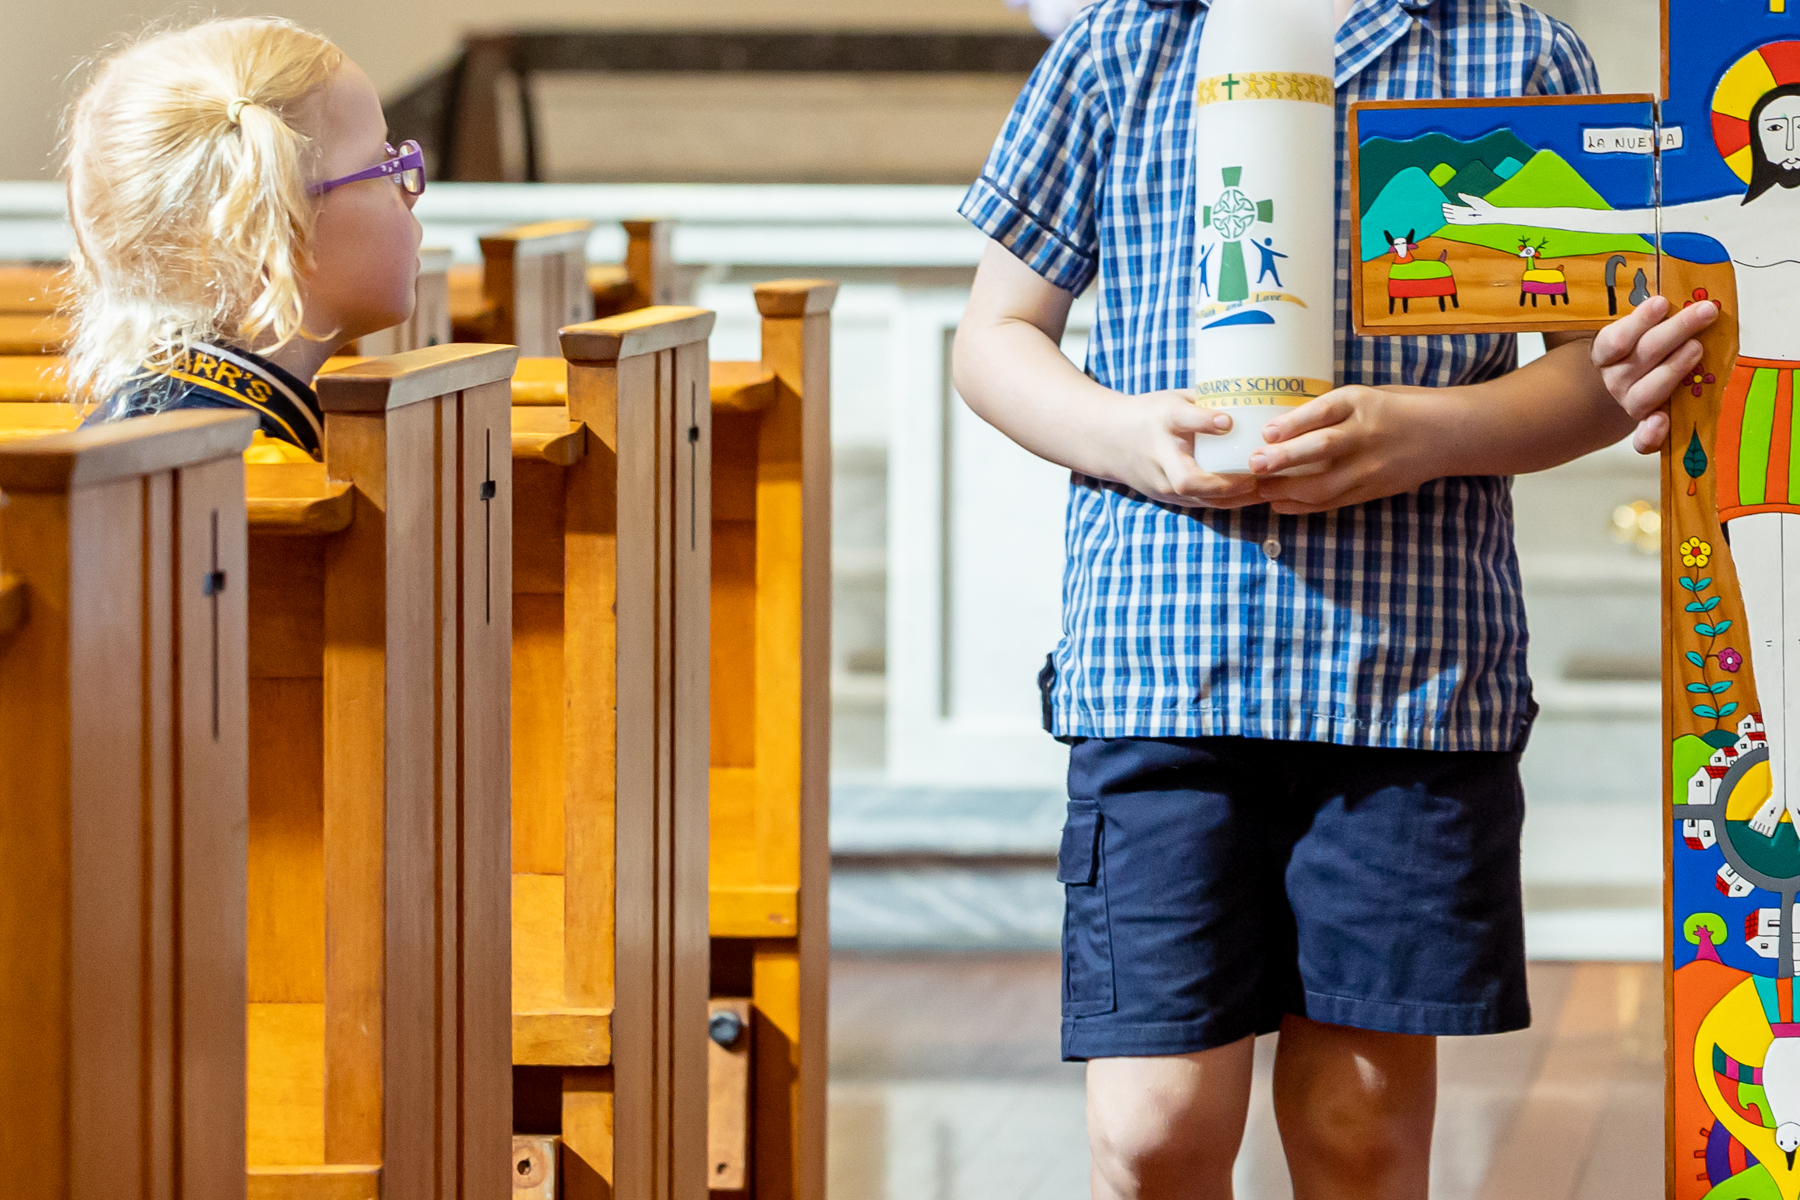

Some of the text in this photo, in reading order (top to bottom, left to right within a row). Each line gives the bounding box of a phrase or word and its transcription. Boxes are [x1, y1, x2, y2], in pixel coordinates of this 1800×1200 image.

[1588, 136, 1605, 149] LA
[1256, 293, 1282, 303] Love
[154, 348, 273, 404] ARR'S
[1246, 377, 1306, 393] SCHOOL
